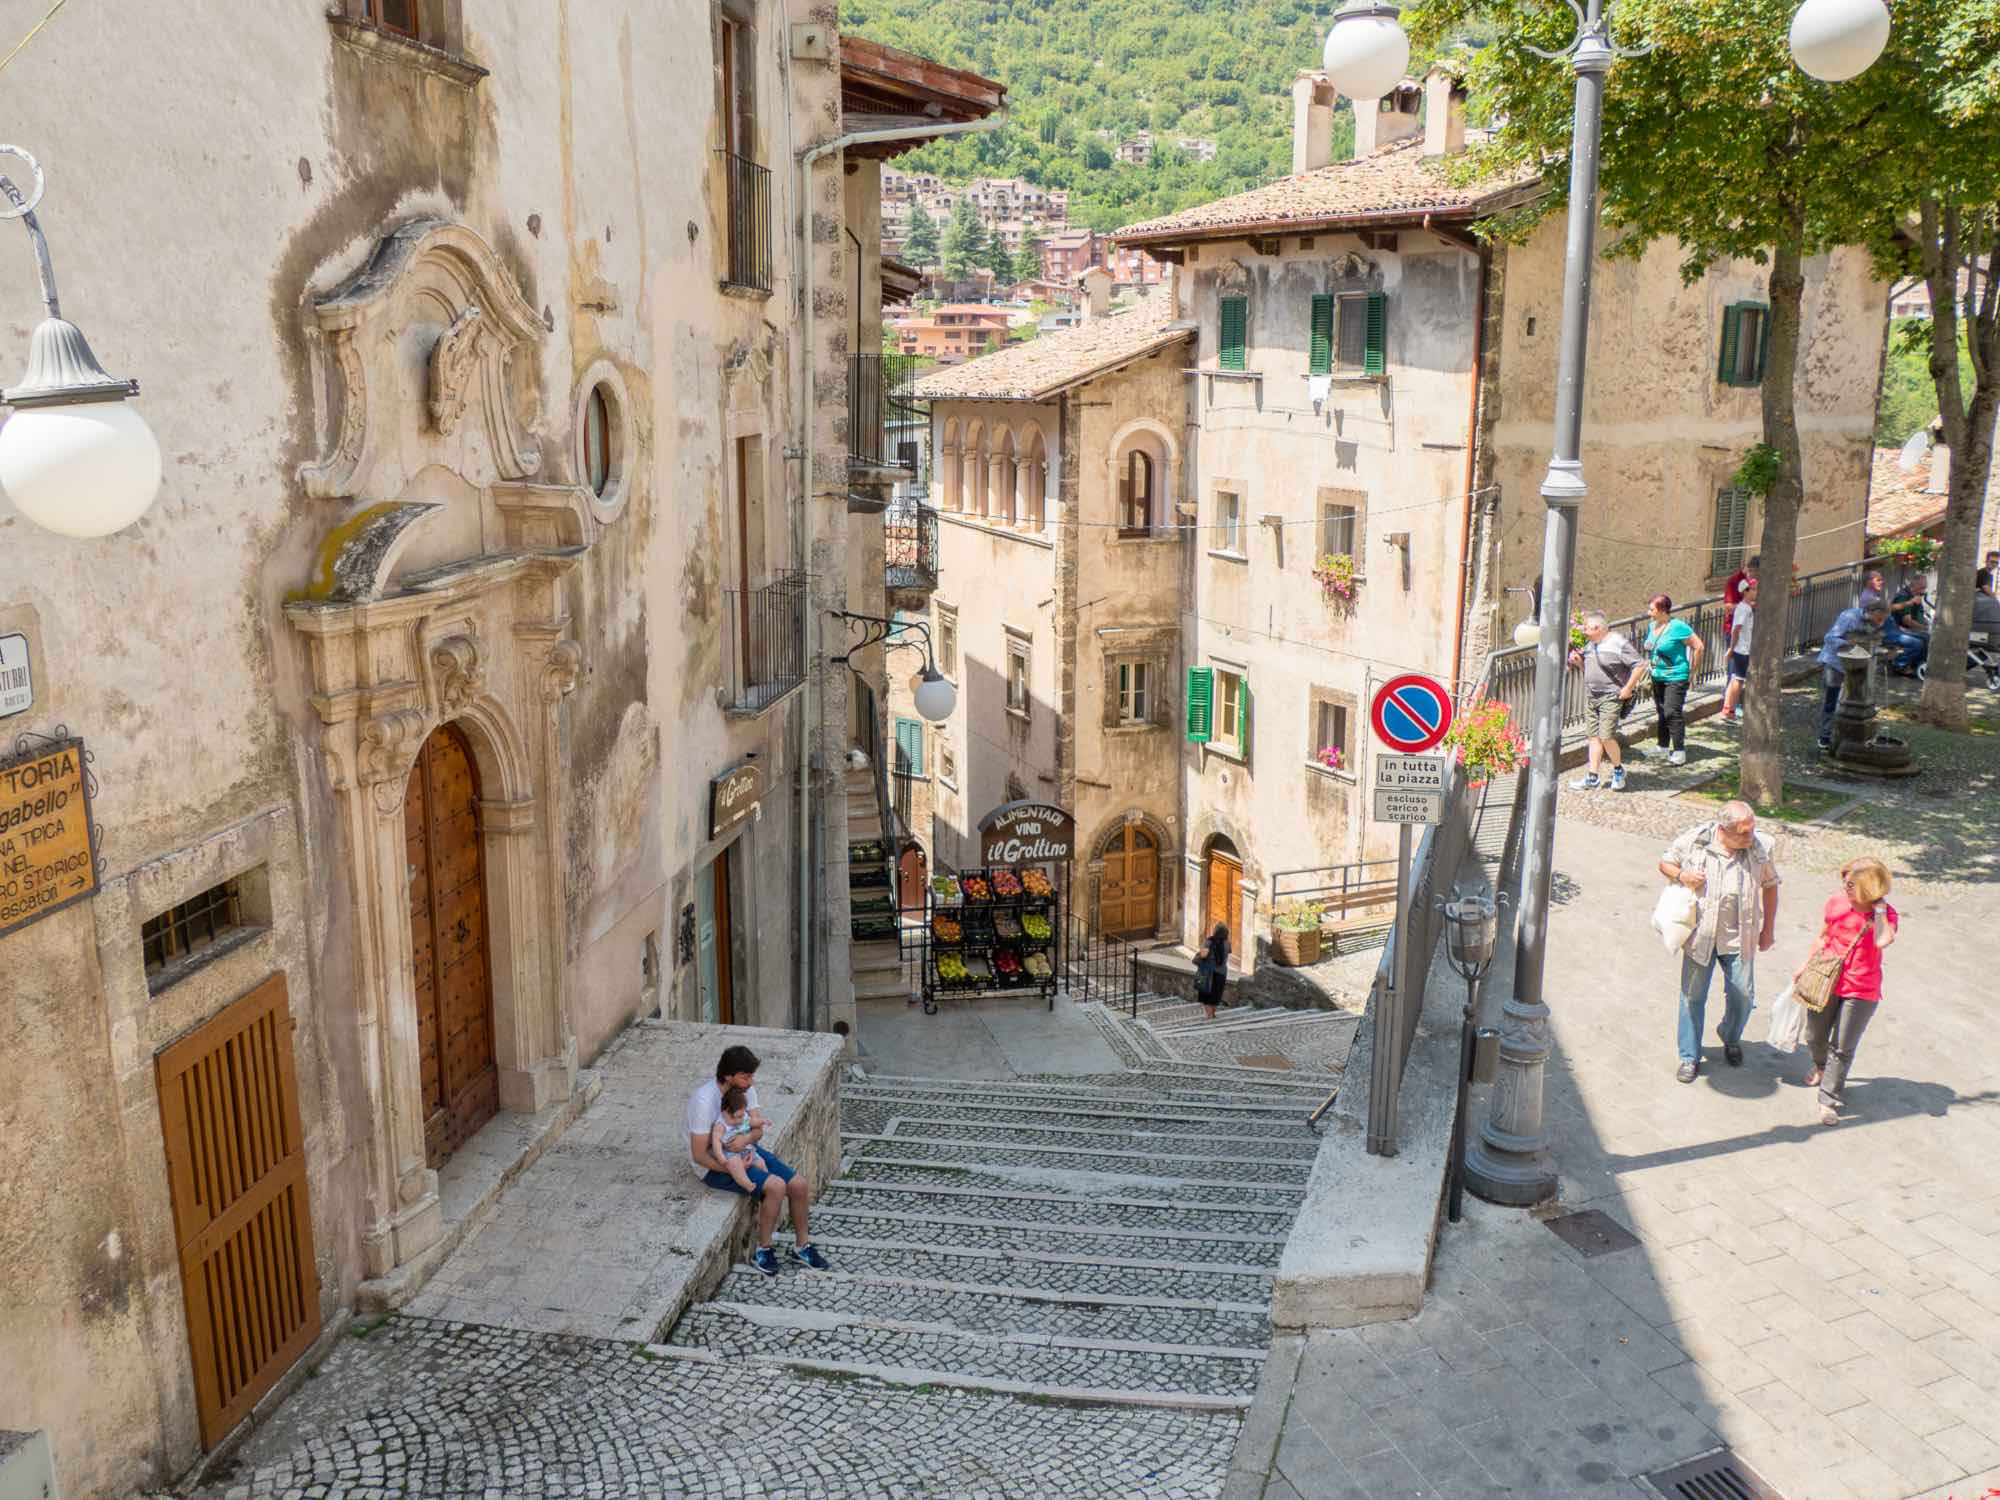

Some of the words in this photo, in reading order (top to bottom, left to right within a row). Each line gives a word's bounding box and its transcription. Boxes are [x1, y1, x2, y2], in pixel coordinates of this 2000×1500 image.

[0, 753, 75, 794] TORIA
[1403, 761, 1437, 772] tutta
[1380, 772, 1393, 782] la
[1398, 773, 1440, 784] piazza
[1387, 795, 1427, 803] escluso
[1386, 804, 1418, 812] carico
[994, 806, 1065, 830] ALIMENTARI
[1388, 813, 1426, 821] scarico
[21, 819, 65, 848] TIPICA
[1015, 822, 1042, 836] VINO
[3, 854, 35, 877] NEL
[24, 851, 88, 890] STORICO
